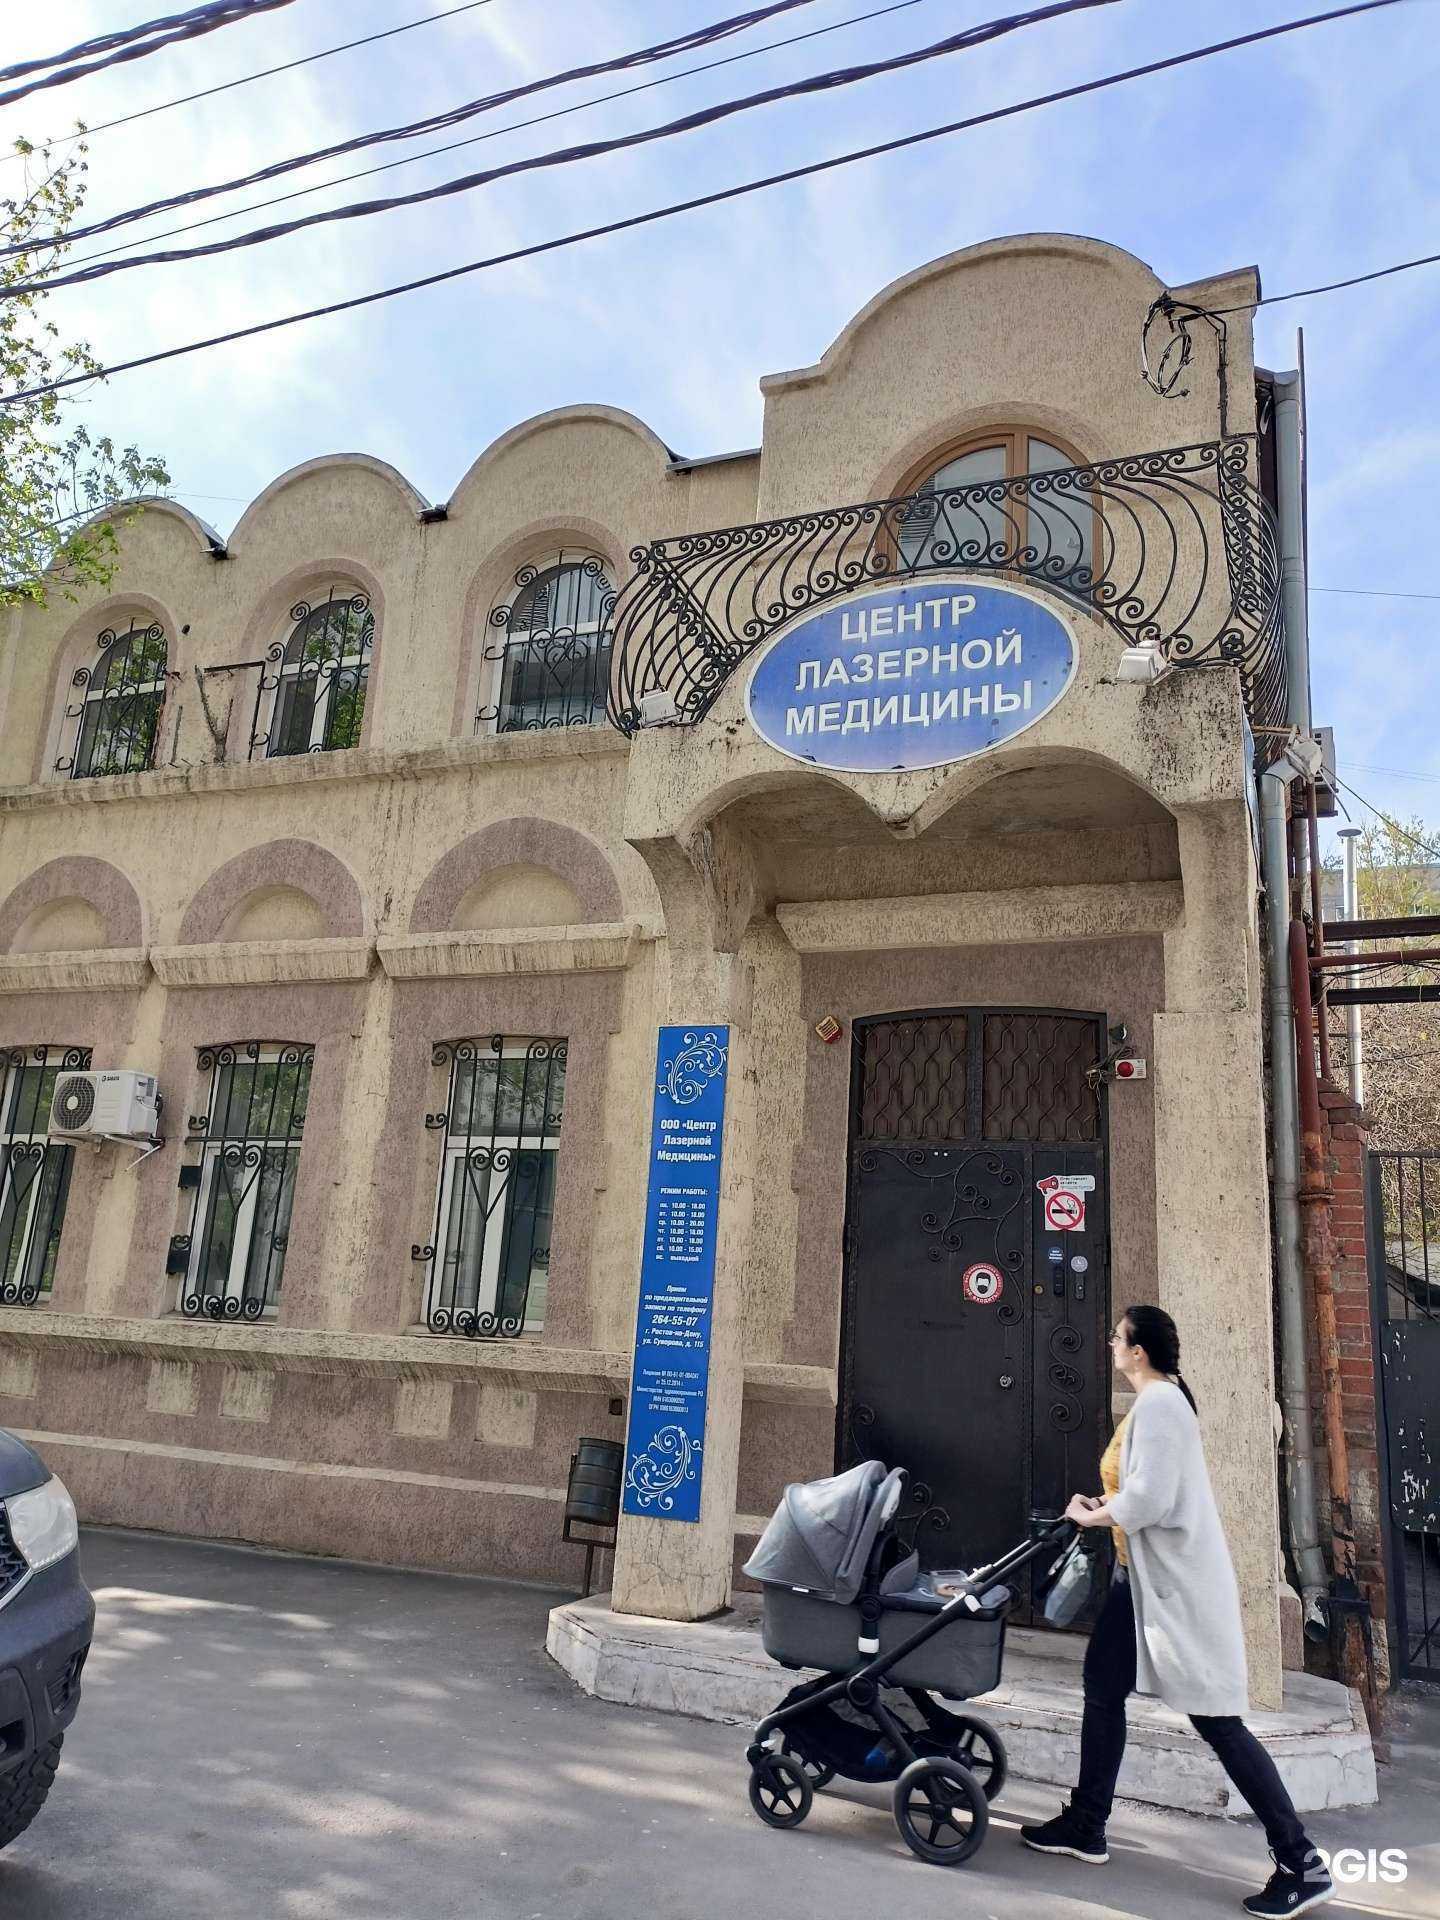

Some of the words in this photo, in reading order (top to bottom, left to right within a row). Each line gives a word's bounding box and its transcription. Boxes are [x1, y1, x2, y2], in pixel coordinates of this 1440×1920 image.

[841, 594, 977, 643] ЦЕНТР
[795, 628, 1023, 691] ЛАЗЕРНОЙ
[785, 679, 1034, 737] МЕДИЦИНЫ
[660, 1119, 680, 1130] ООО
[682, 1119, 717, 1132] «Центр
[663, 1134, 712, 1147] Лазерной
[660, 1187, 681, 1195] РЕЖИМ
[682, 1188, 709, 1196] РАБОТЫ:
[651, 1314, 699, 1327] 264-55-07
